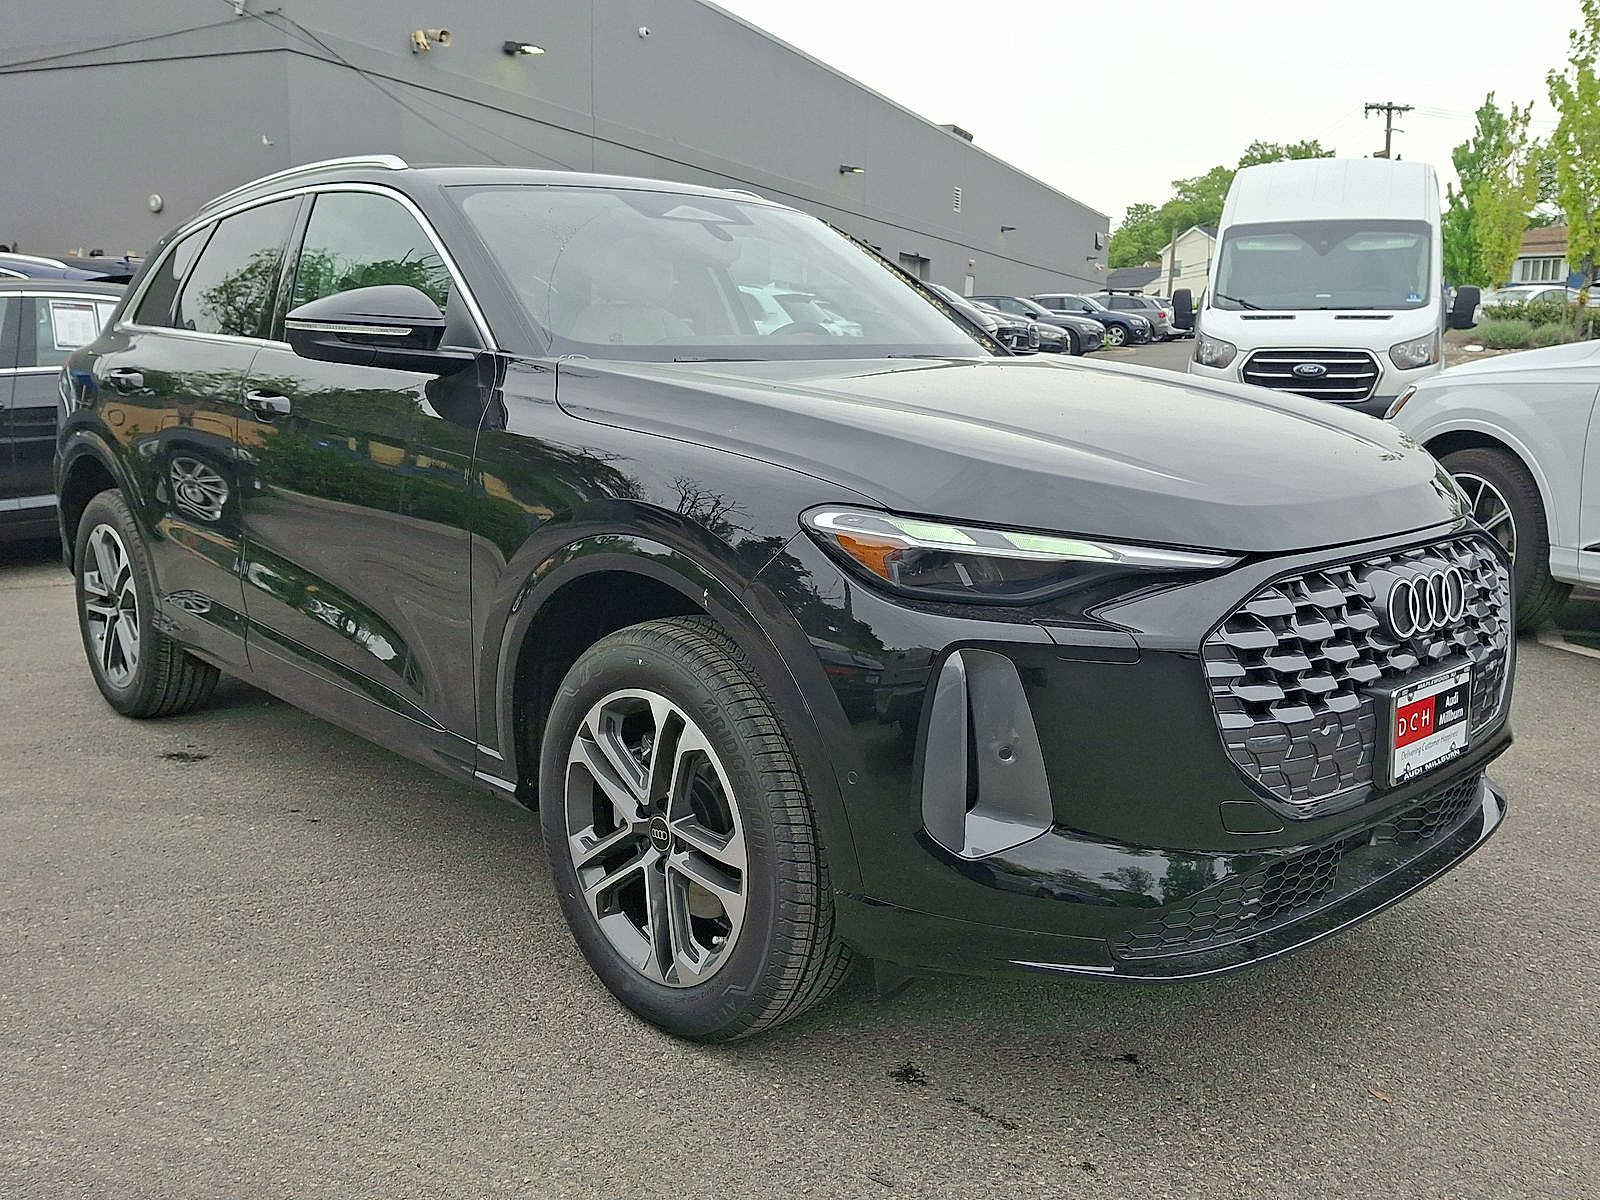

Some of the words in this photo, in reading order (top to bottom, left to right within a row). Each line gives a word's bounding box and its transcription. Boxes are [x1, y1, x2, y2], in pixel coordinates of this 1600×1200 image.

[1445, 692, 1459, 708] Audi
[1438, 708, 1464, 726] Millburn
[1404, 768, 1423, 780] AUDI
[1425, 749, 1461, 771] MILLBURN
